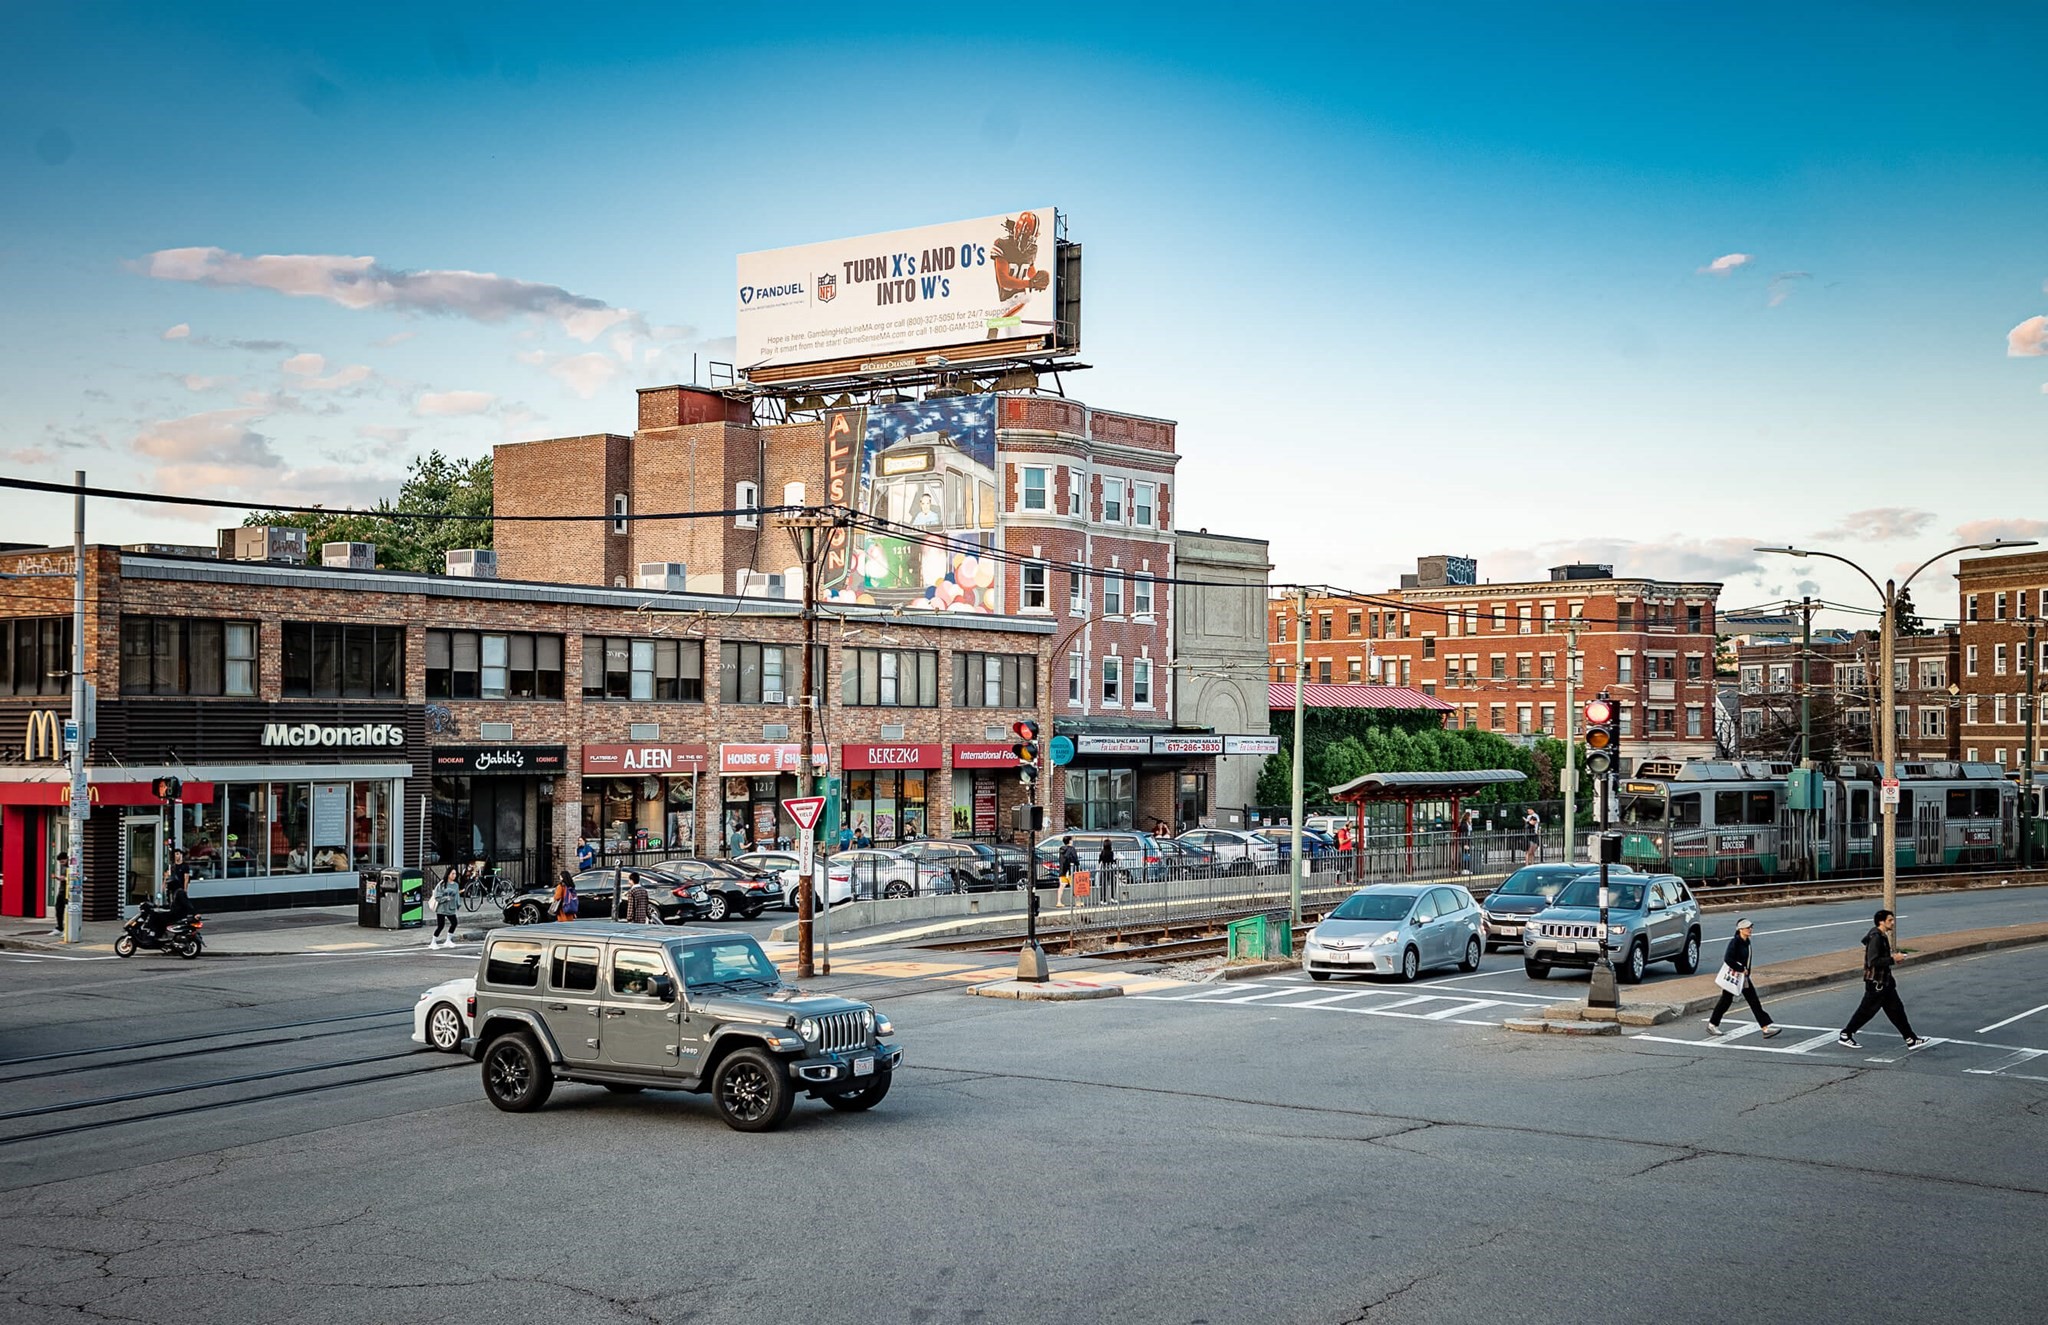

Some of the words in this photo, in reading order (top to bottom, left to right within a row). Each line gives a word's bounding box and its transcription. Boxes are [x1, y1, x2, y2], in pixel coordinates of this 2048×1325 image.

[843, 256, 887, 284] TURN
[892, 253, 915, 277] X's
[921, 246, 955, 273] AND
[961, 243, 985, 268] O's
[757, 283, 804, 299] FANDUEL
[820, 285, 834, 298] NFL
[877, 278, 915, 306] INTO
[921, 275, 950, 300] W's
[768, 336, 783, 345] Hope
[957, 311, 965, 320] for
[967, 309, 982, 318] 24/7
[760, 347, 773, 356] Play
[780, 344, 798, 353] smart
[799, 342, 814, 351] from
[815, 340, 824, 348] the
[263, 723, 404, 747] McDonald's
[960, 750, 1002, 760] International
[1168, 743, 1220, 751] 617-286-3830
[475, 750, 524, 770] Habibi's
[624, 749, 672, 769] AJEEN
[727, 753, 757, 764] HOUSE
[759, 753, 771, 764] OF
[784, 753, 828, 765] SHARMA
[869, 748, 919, 763] BEREZKA
[755, 782, 774, 792] 1217
[681, 1045, 698, 1055] Jeep
